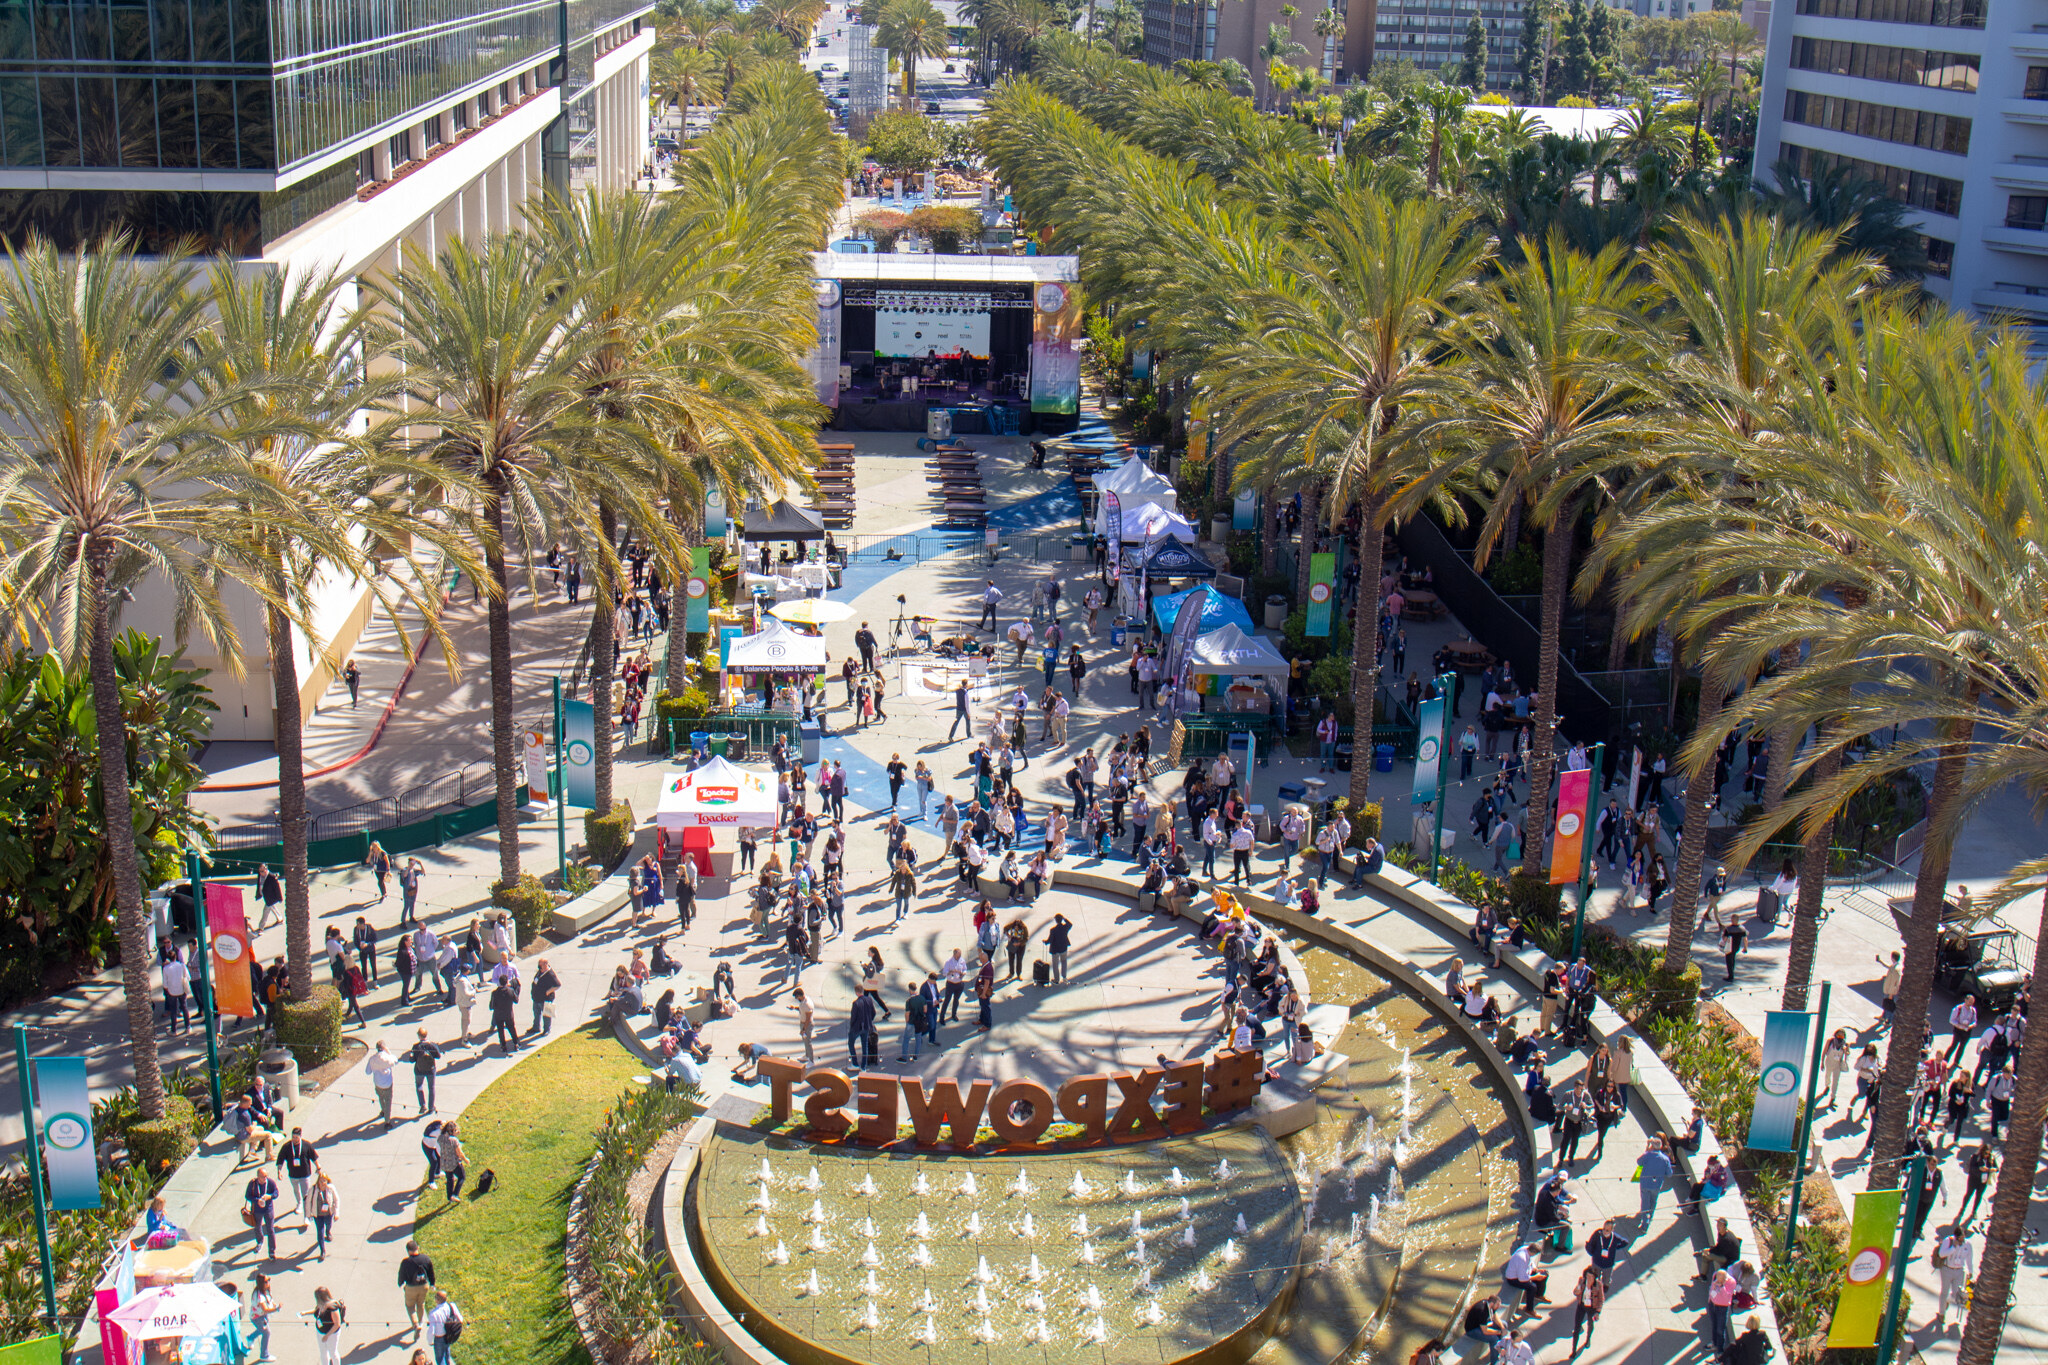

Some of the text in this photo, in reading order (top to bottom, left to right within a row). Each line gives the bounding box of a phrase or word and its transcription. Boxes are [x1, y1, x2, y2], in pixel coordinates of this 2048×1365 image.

[1046, 324, 1061, 398] PASSION
[700, 788, 736, 797] Loacker
[694, 813, 739, 824] Loacker
[154, 1314, 188, 1327] ROAR
